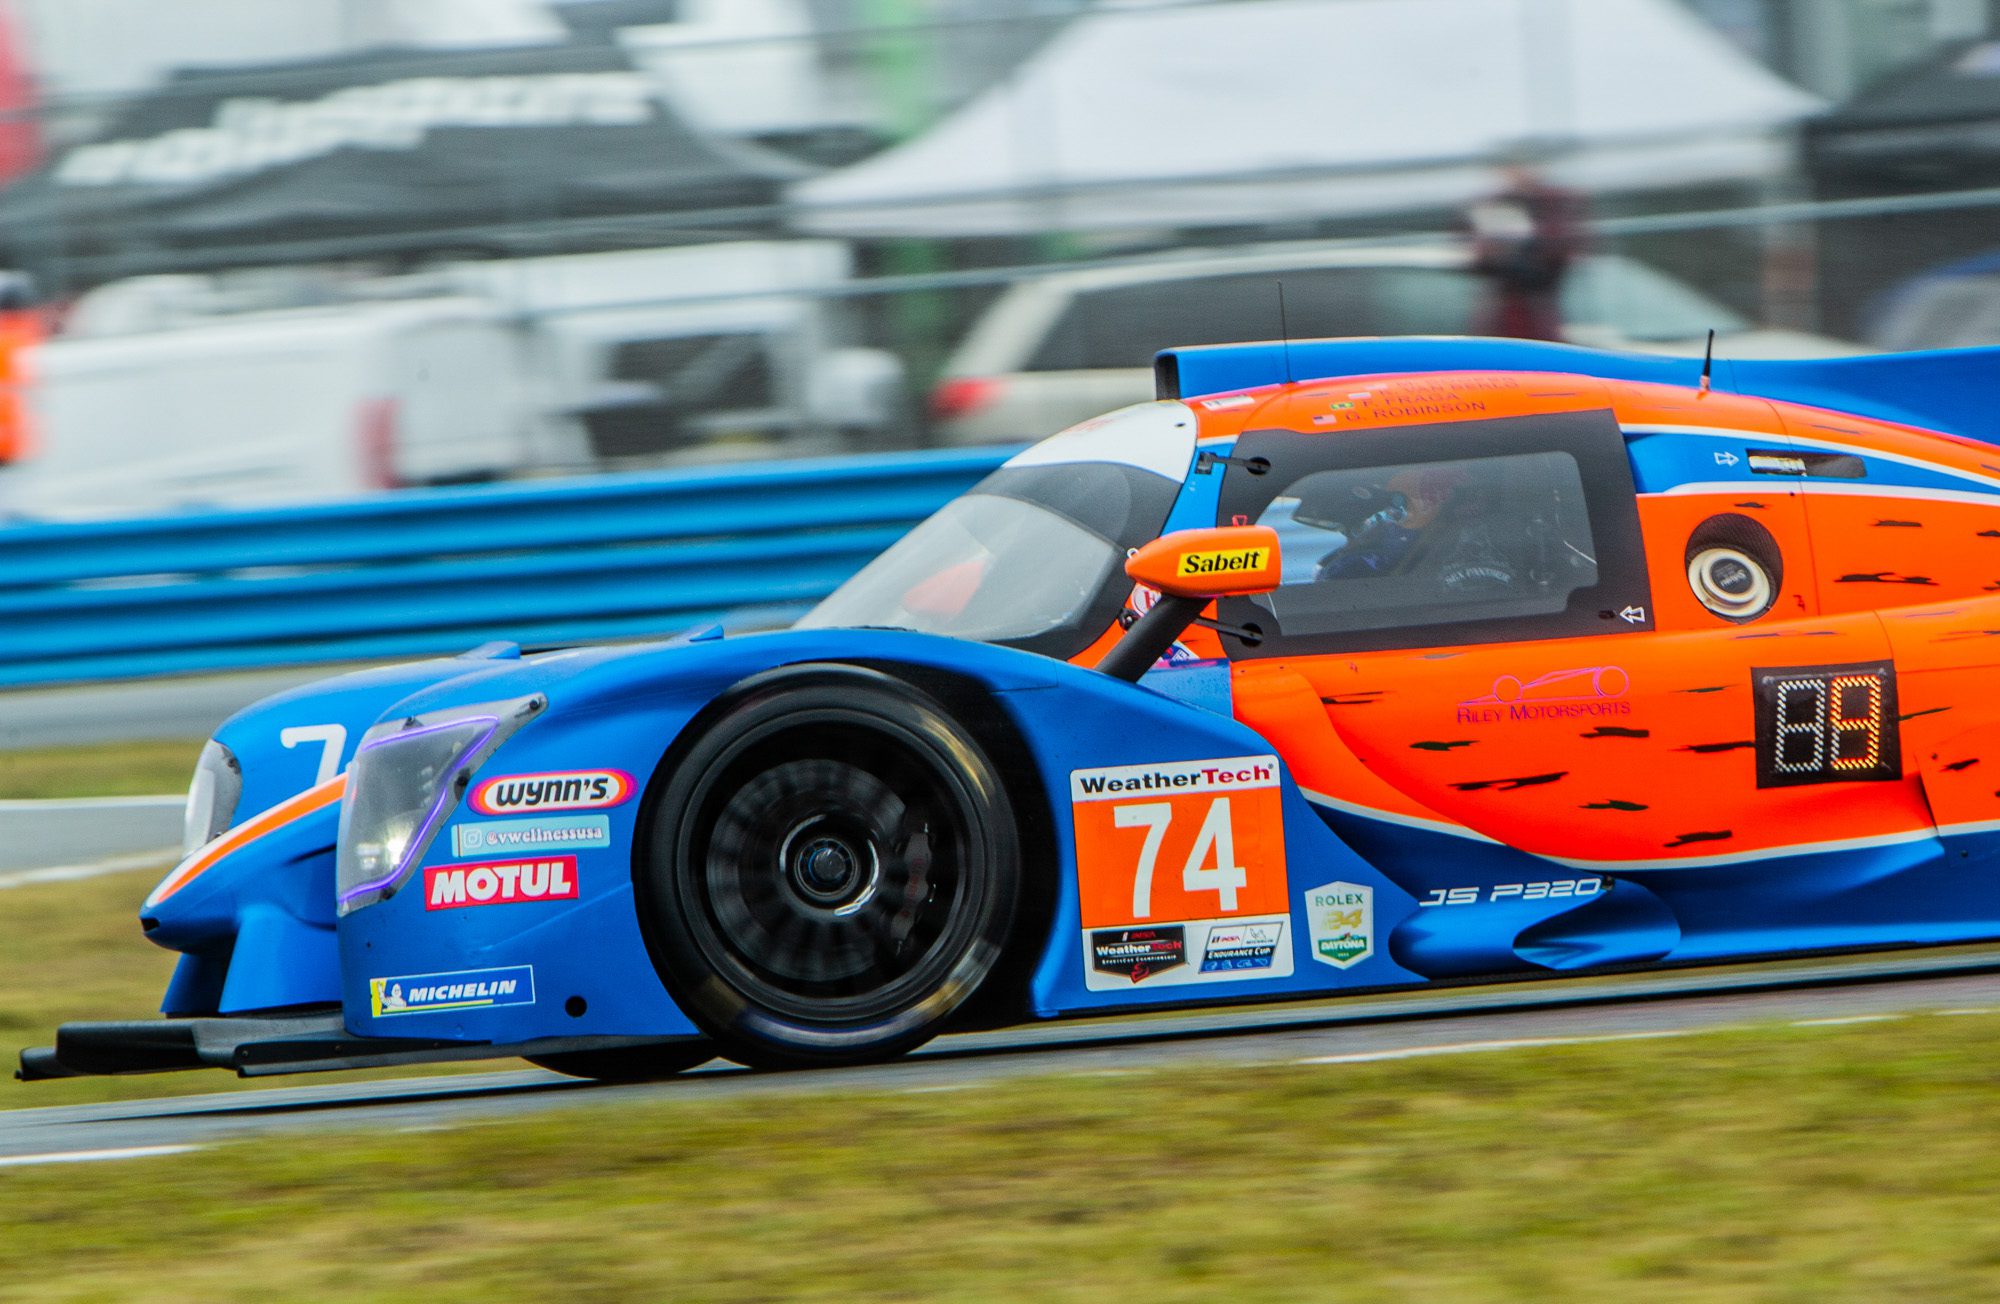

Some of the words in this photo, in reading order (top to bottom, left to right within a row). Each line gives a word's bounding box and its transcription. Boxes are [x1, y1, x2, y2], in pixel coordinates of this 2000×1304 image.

[1374, 401, 1487, 419] ROBINSON
[1184, 550, 1261, 574] Sabelt
[1457, 707, 1501, 725] RILEY
[1510, 701, 1632, 721] MOTORSPORTS
[1113, 797, 1247, 919] 74
[431, 862, 571, 905] MOTUL
[1419, 886, 1480, 907] JS
[1490, 877, 1602, 903] P320
[1315, 893, 1364, 907] ROLEX
[1096, 940, 1182, 957] WeatherTech
[1321, 939, 1365, 951] DAYTONA
[408, 980, 517, 1003] MICHELIN
